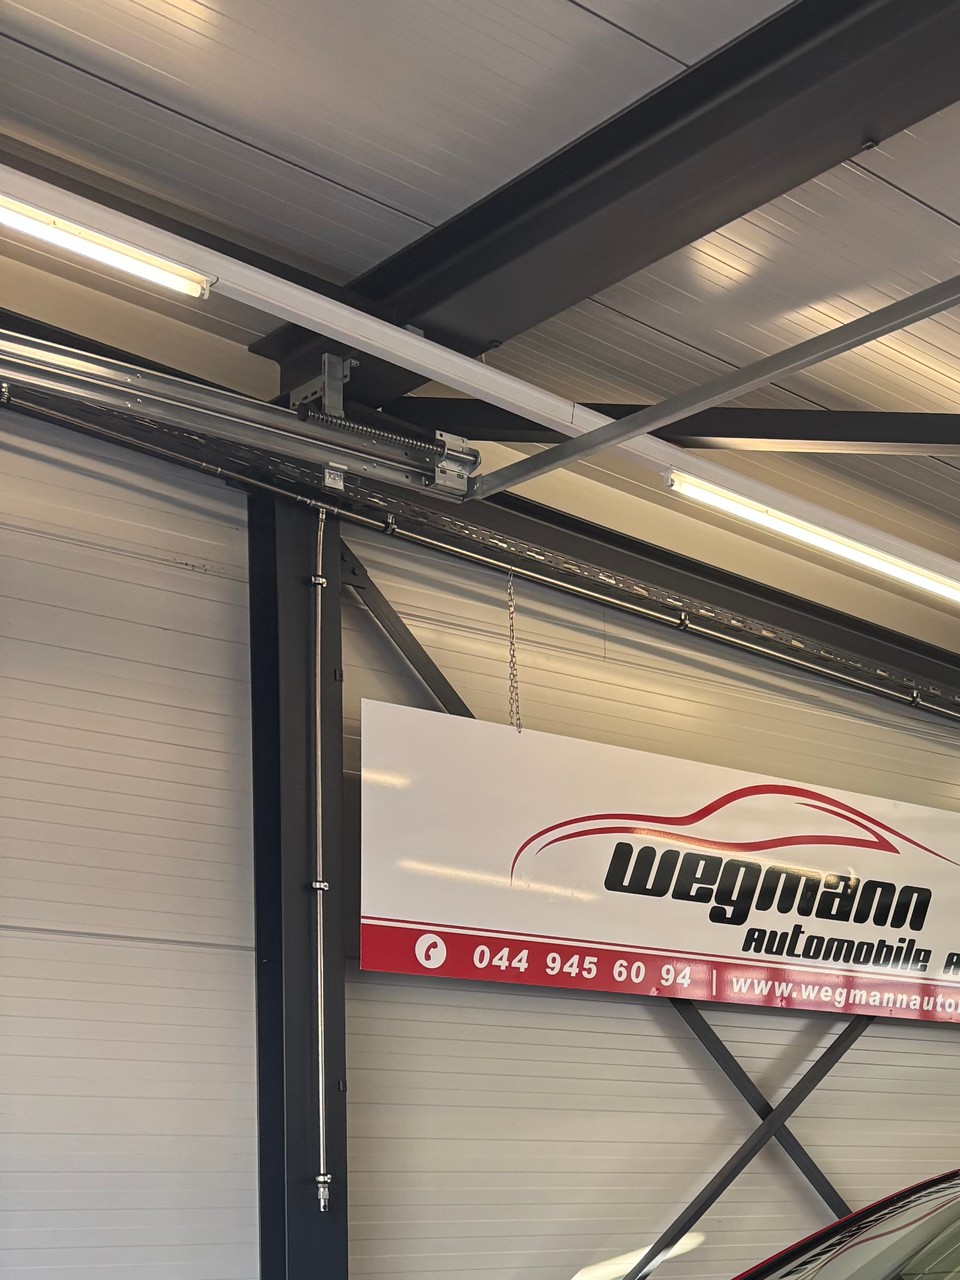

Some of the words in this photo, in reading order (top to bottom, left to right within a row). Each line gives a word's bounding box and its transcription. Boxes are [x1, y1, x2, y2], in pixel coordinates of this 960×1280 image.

[472, 945, 529, 972] 044
[545, 952, 598, 979] 945
[612, 959, 645, 983] 60
[660, 964, 692, 988] 94
